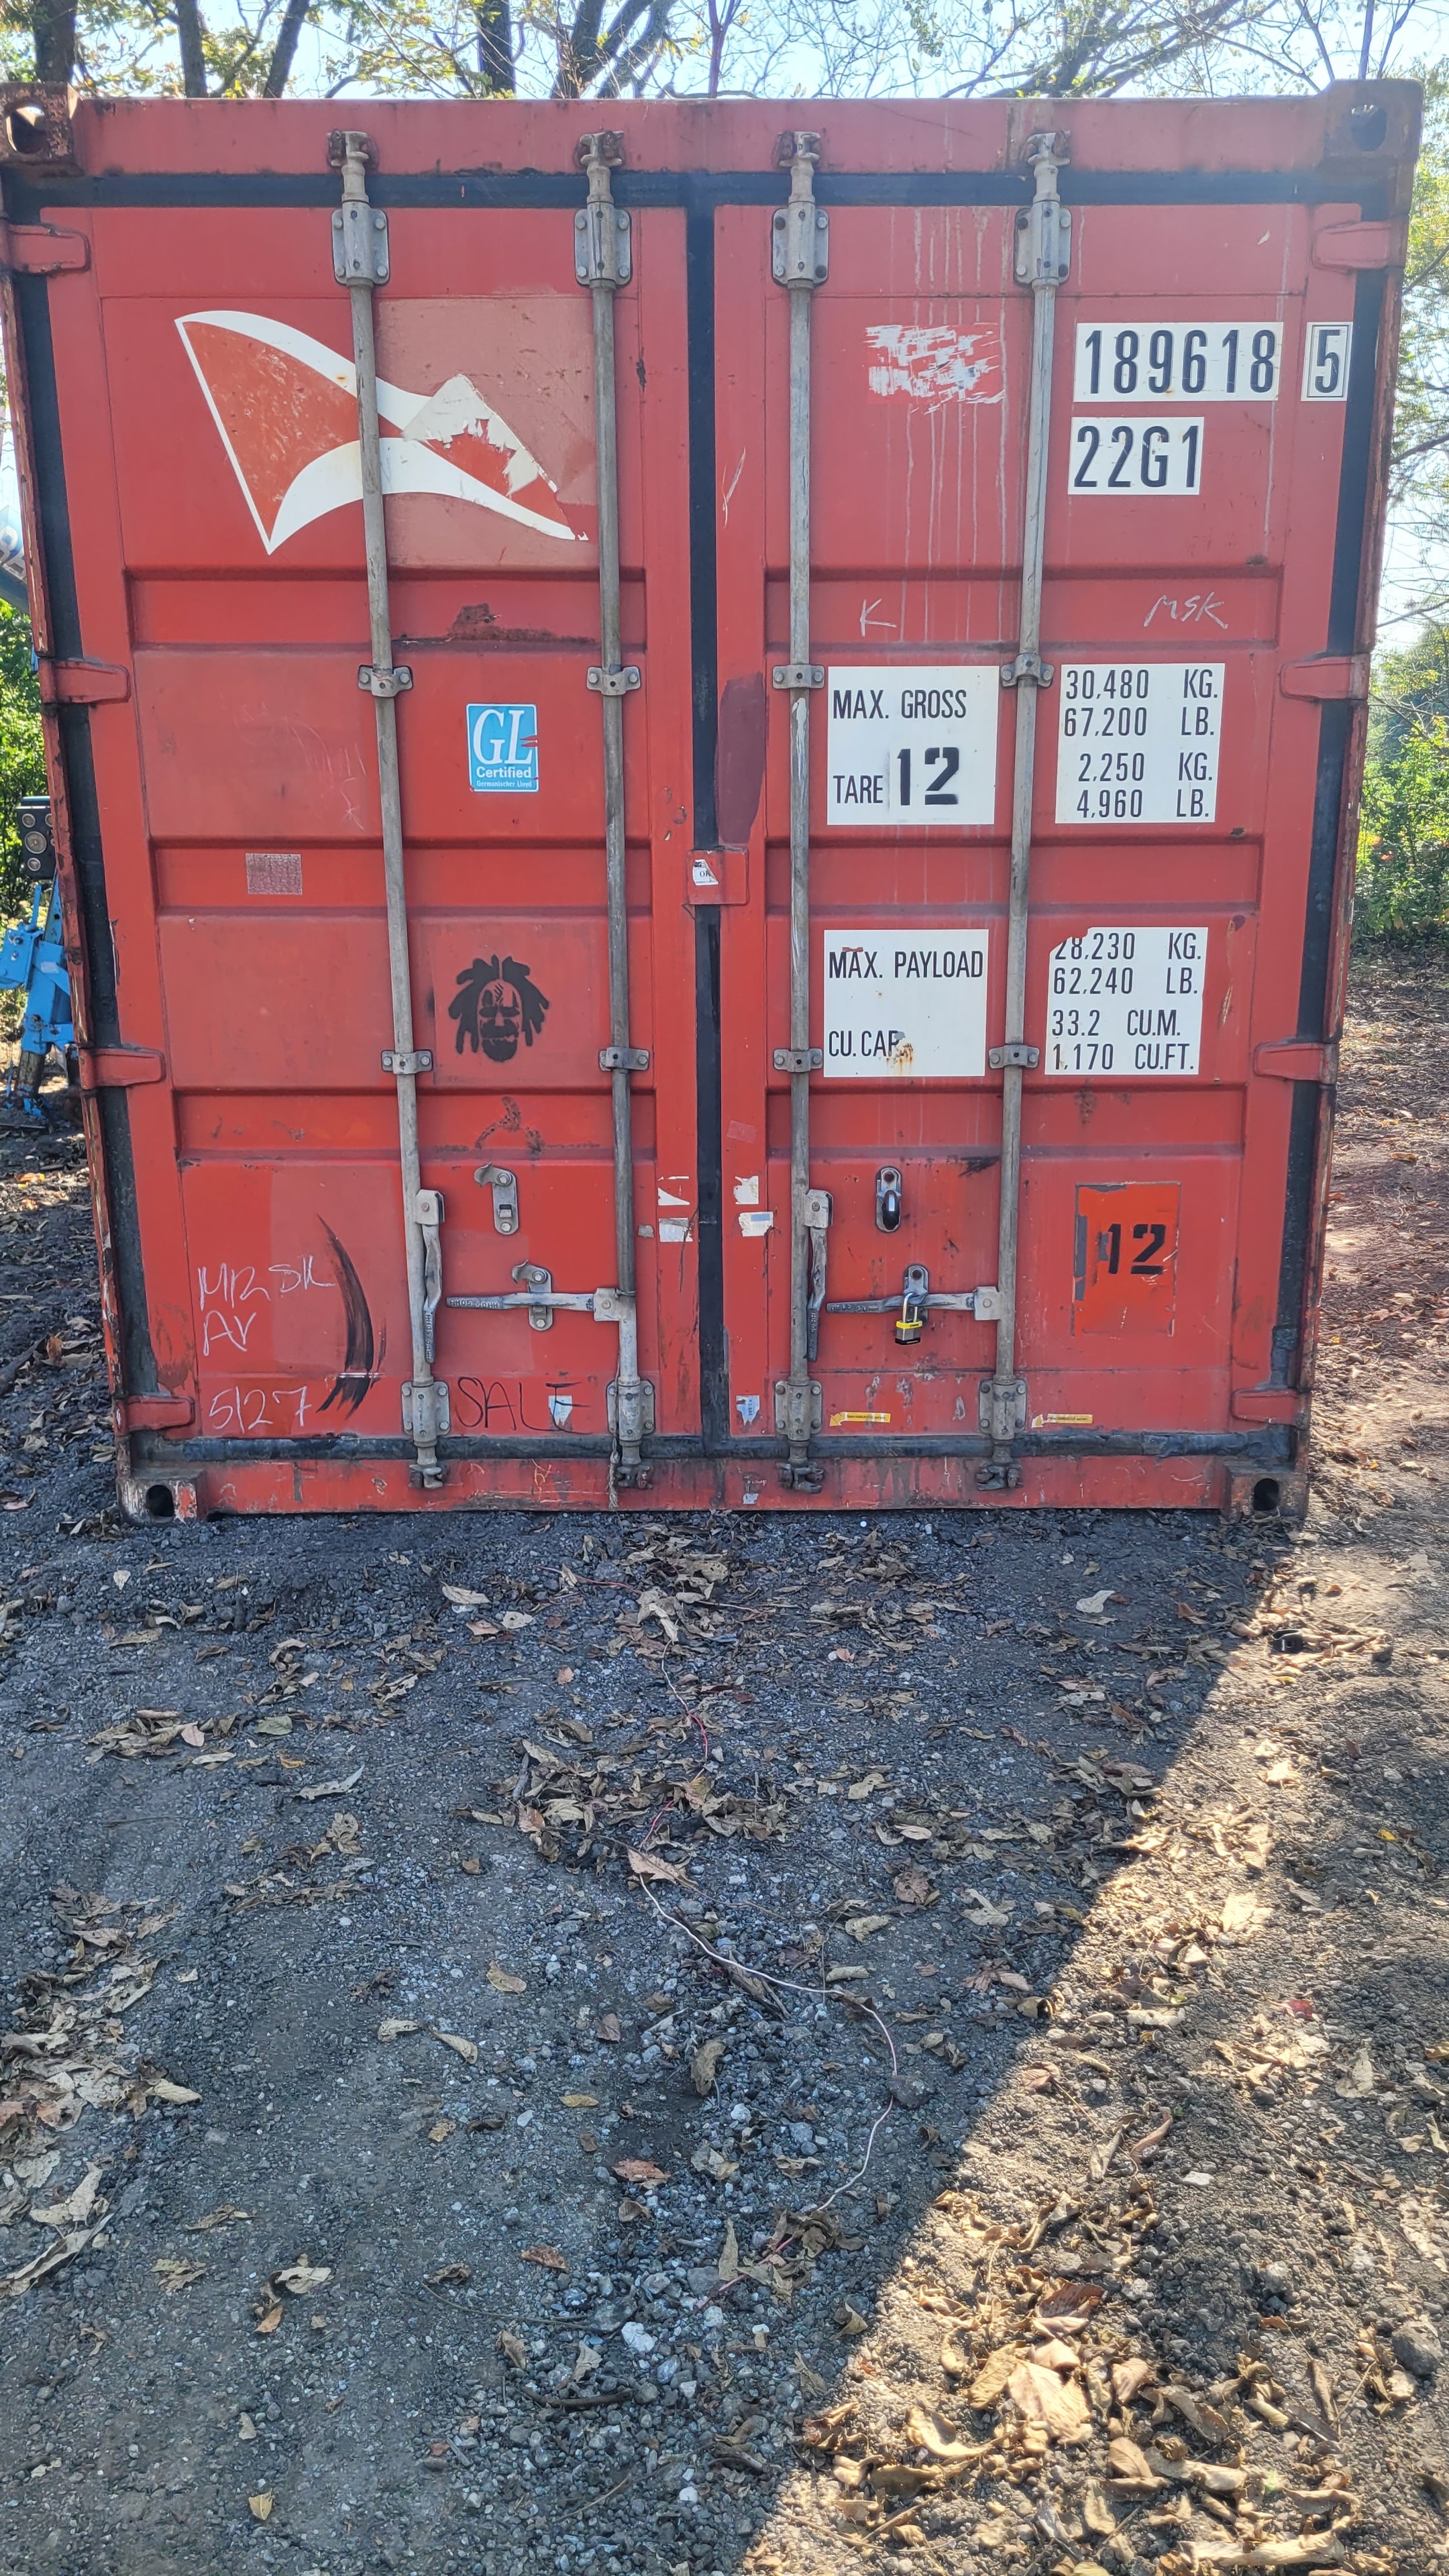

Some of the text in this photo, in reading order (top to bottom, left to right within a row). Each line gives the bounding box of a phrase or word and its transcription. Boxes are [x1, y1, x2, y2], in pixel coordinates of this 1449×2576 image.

[1085, 329, 1276, 394] 189618
[1314, 329, 1341, 393] 5
[1074, 425, 1199, 488] 22G1
[1066, 669, 1218, 699] 30,480 KG.
[833, 689, 967, 718] MAX. GROSS
[1064, 706, 1214, 737] 67,200 LB.
[473, 708, 533, 765] GL
[476, 766, 531, 778] Certified
[897, 747, 959, 806] 12
[1078, 752, 1213, 782] 2,250 KG.
[517, 780, 532, 788] Lloyd
[833, 775, 883, 804] TARE
[1077, 789, 1209, 818] 4,960 LB.
[1055, 932, 1201, 960] 28,230 KG.
[828, 951, 983, 978] MAX. PAYLOAD
[1053, 967, 1197, 994] 62,240 LB.
[1052, 1009, 1181, 1036] 33.2 CU.M.
[1053, 1043, 1194, 1070] 1,170 CU.FT.
[1108, 1224, 1166, 1275] 12
